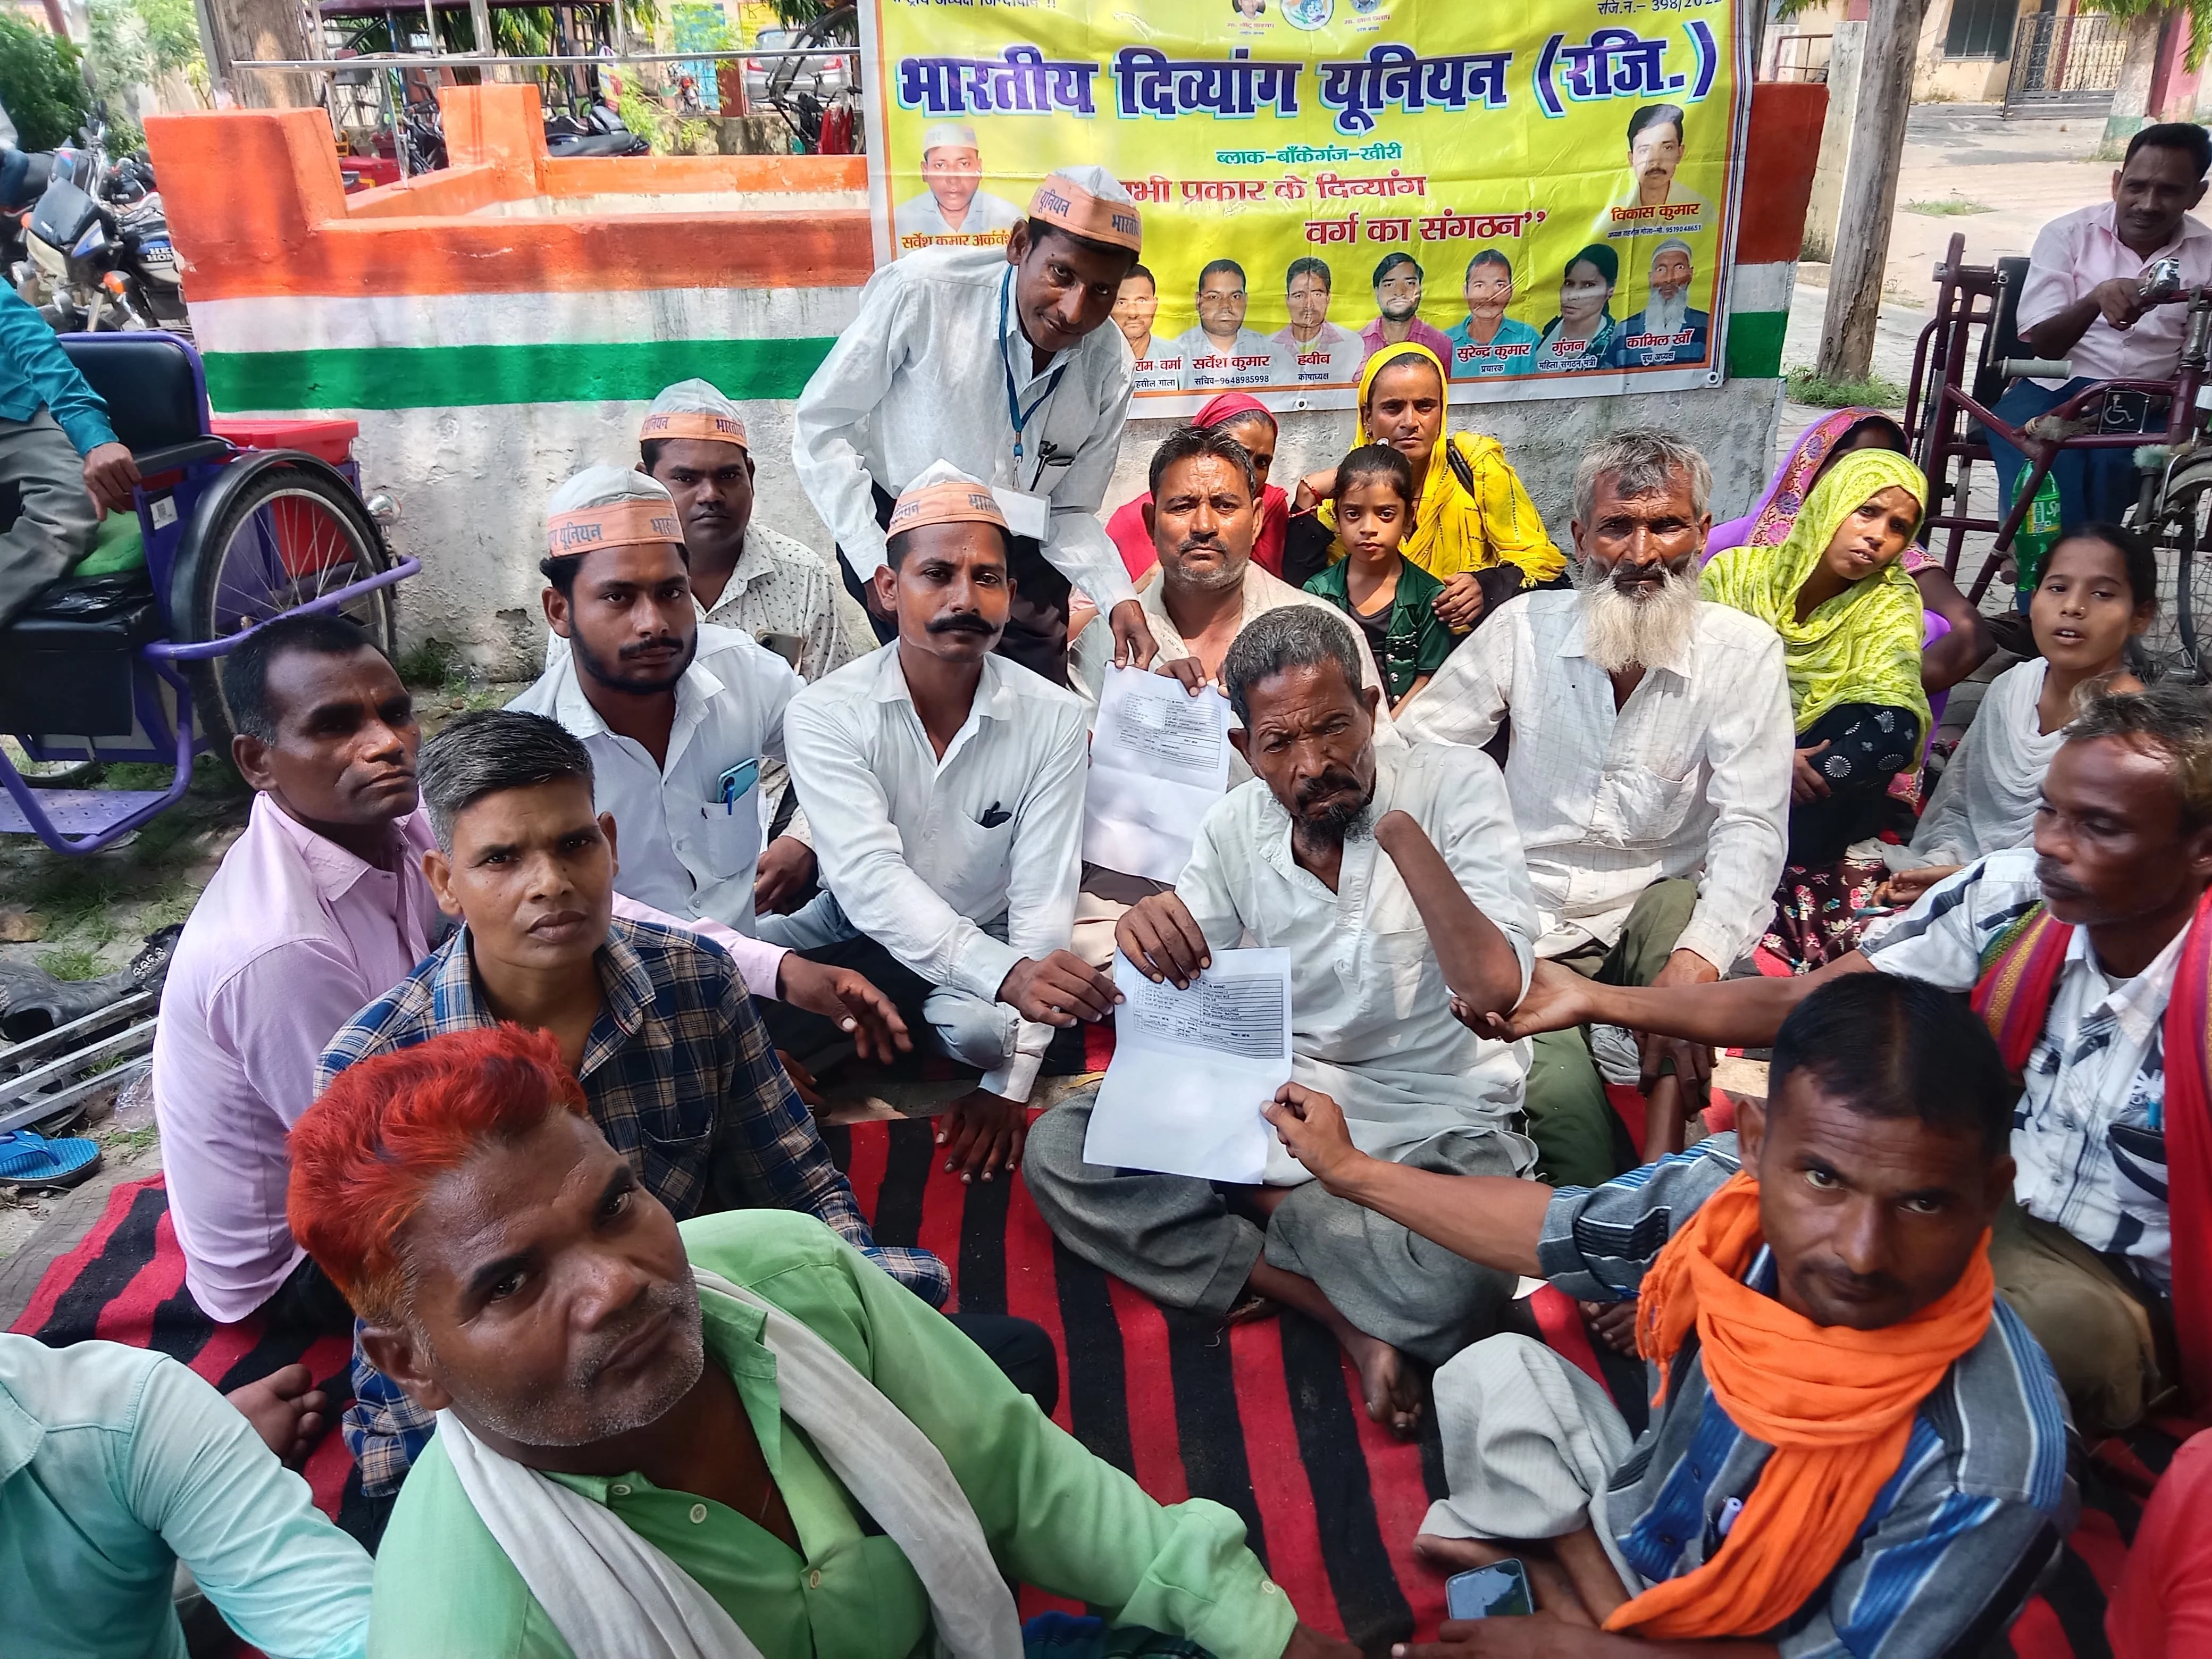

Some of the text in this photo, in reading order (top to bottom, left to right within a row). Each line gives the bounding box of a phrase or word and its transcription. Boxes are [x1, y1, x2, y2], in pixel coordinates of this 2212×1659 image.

[1652, 0, 1722, 12] 398/20
[898, 22, 1718, 136] भारतीय दिव्यांग यूनियन (रजि.)
[1180, 180, 1268, 205] प्रकार
[1273, 175, 1307, 199] के
[1316, 169, 1427, 199] दिव्यांग
[1611, 204, 1700, 221] विकास कुमार
[1305, 213, 1359, 245] वर्ग
[1367, 215, 1411, 244] का
[901, 233, 933, 248] सर्वेश
[146, 254, 174, 262] HON
[1552, 339, 1586, 356] गुंजन
[1627, 333, 1671, 347] कामिल
[1297, 351, 1331, 365] हबीब
[1457, 345, 1531, 363] सुरेन्द्र कुमार
[1160, 356, 1182, 370] वर्मा
[1193, 355, 1270, 371] सर्वेश कुमार
[1539, 360, 1558, 370] महिला
[1135, 378, 1155, 388] हसील
[560, 522, 602, 550] यूनियन
